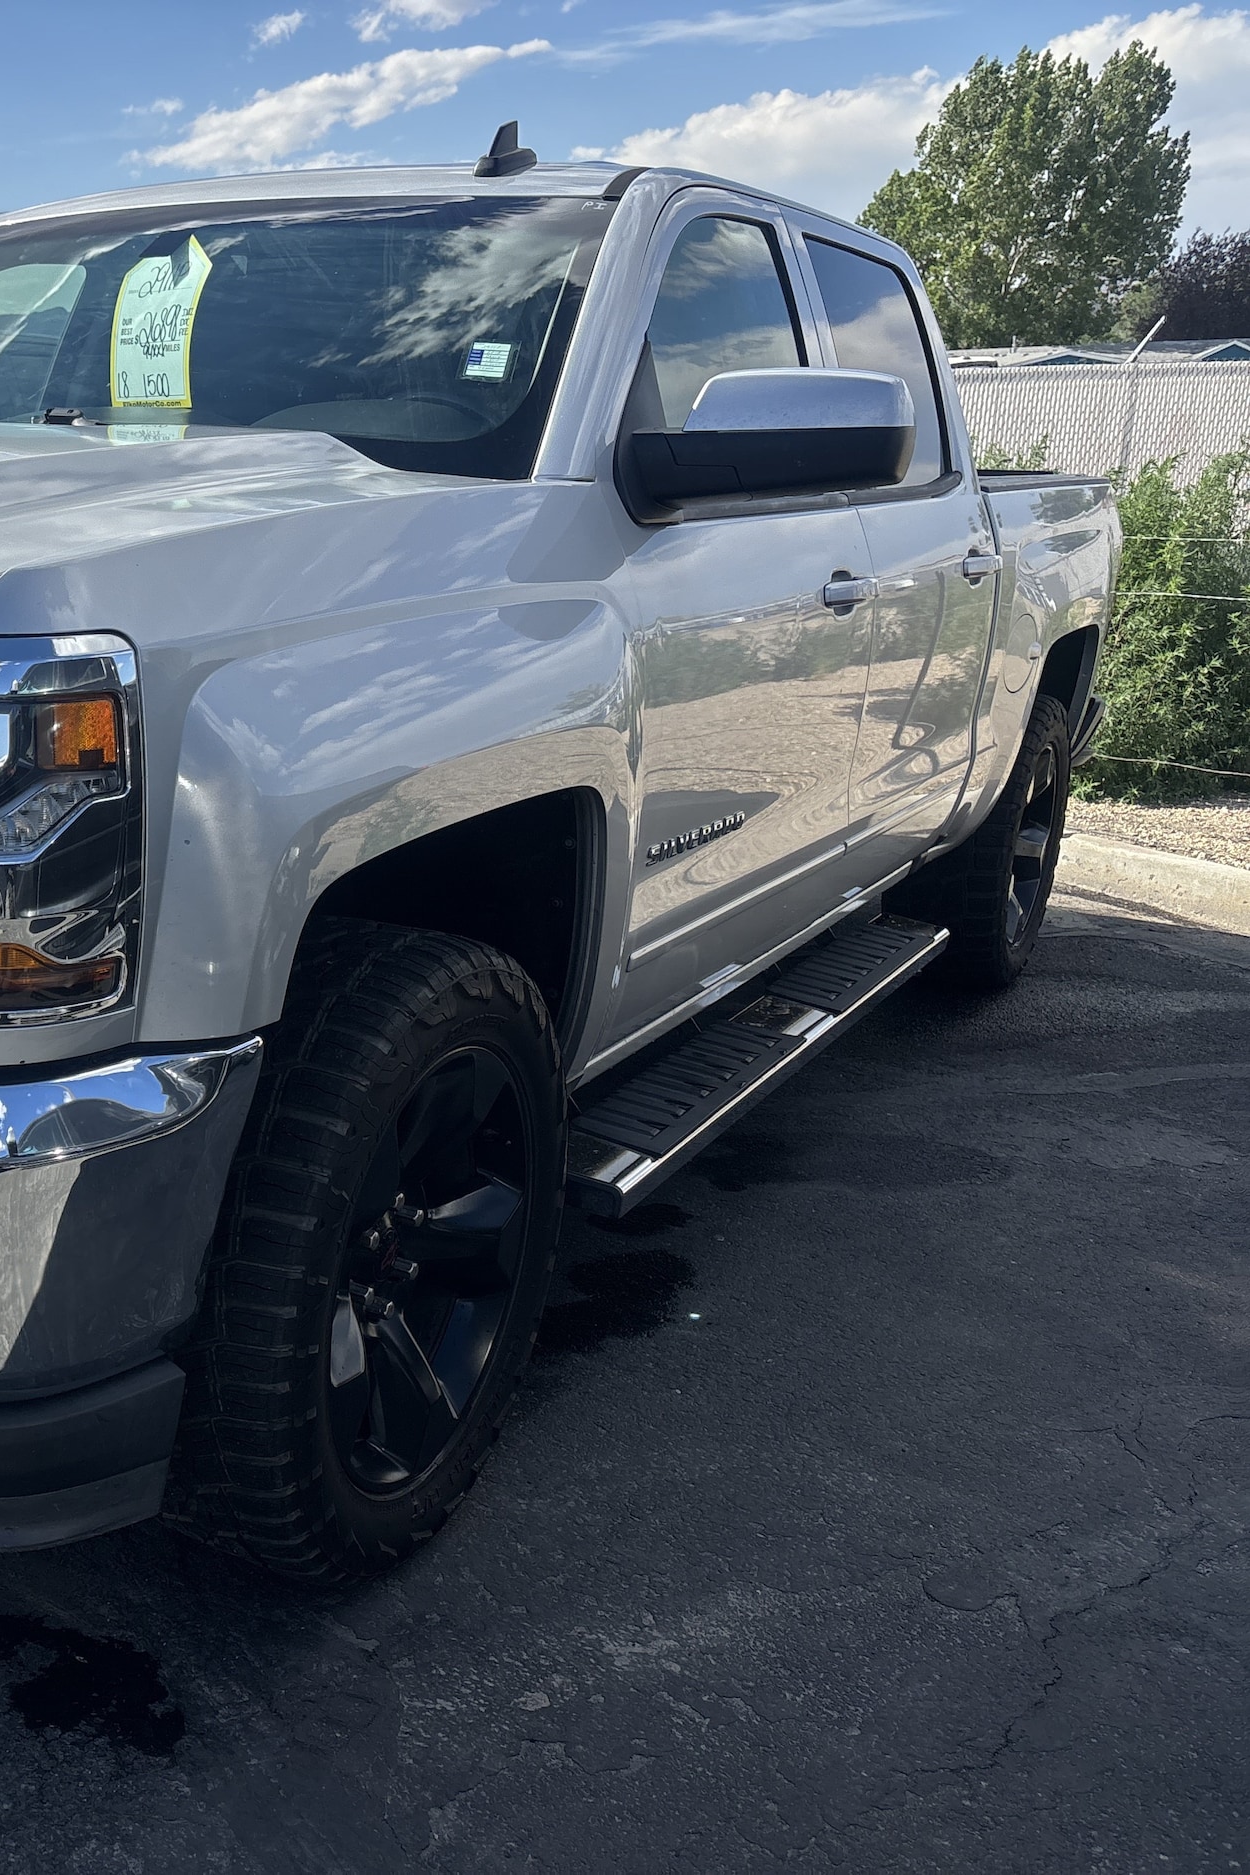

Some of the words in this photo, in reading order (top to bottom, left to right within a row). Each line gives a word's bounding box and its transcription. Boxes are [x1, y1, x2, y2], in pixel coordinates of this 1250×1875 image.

[122, 318, 133, 326] OUR
[120, 328, 134, 336] BEST
[120, 337, 134, 346] PRICE
[117, 370, 130, 399] 18
[142, 372, 170, 399] 1500
[645, 810, 746, 867] SILVERADO
